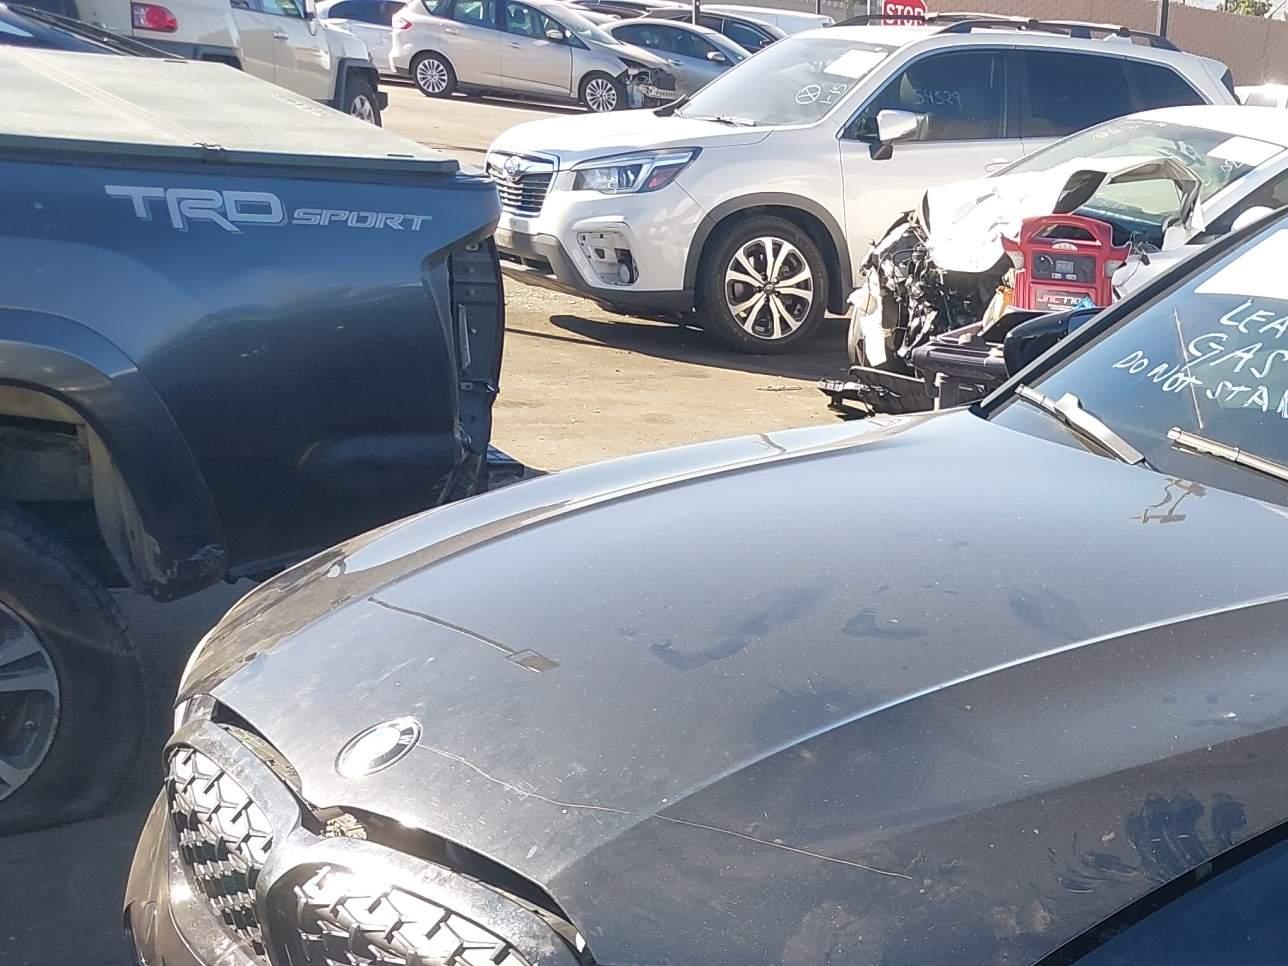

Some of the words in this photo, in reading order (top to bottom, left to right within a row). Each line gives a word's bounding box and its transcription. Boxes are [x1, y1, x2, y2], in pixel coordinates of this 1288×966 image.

[886, 4, 924, 26] STOP
[104, 184, 287, 233] TRD
[292, 208, 432, 231] SPORT
[1112, 350, 1149, 375] DO
